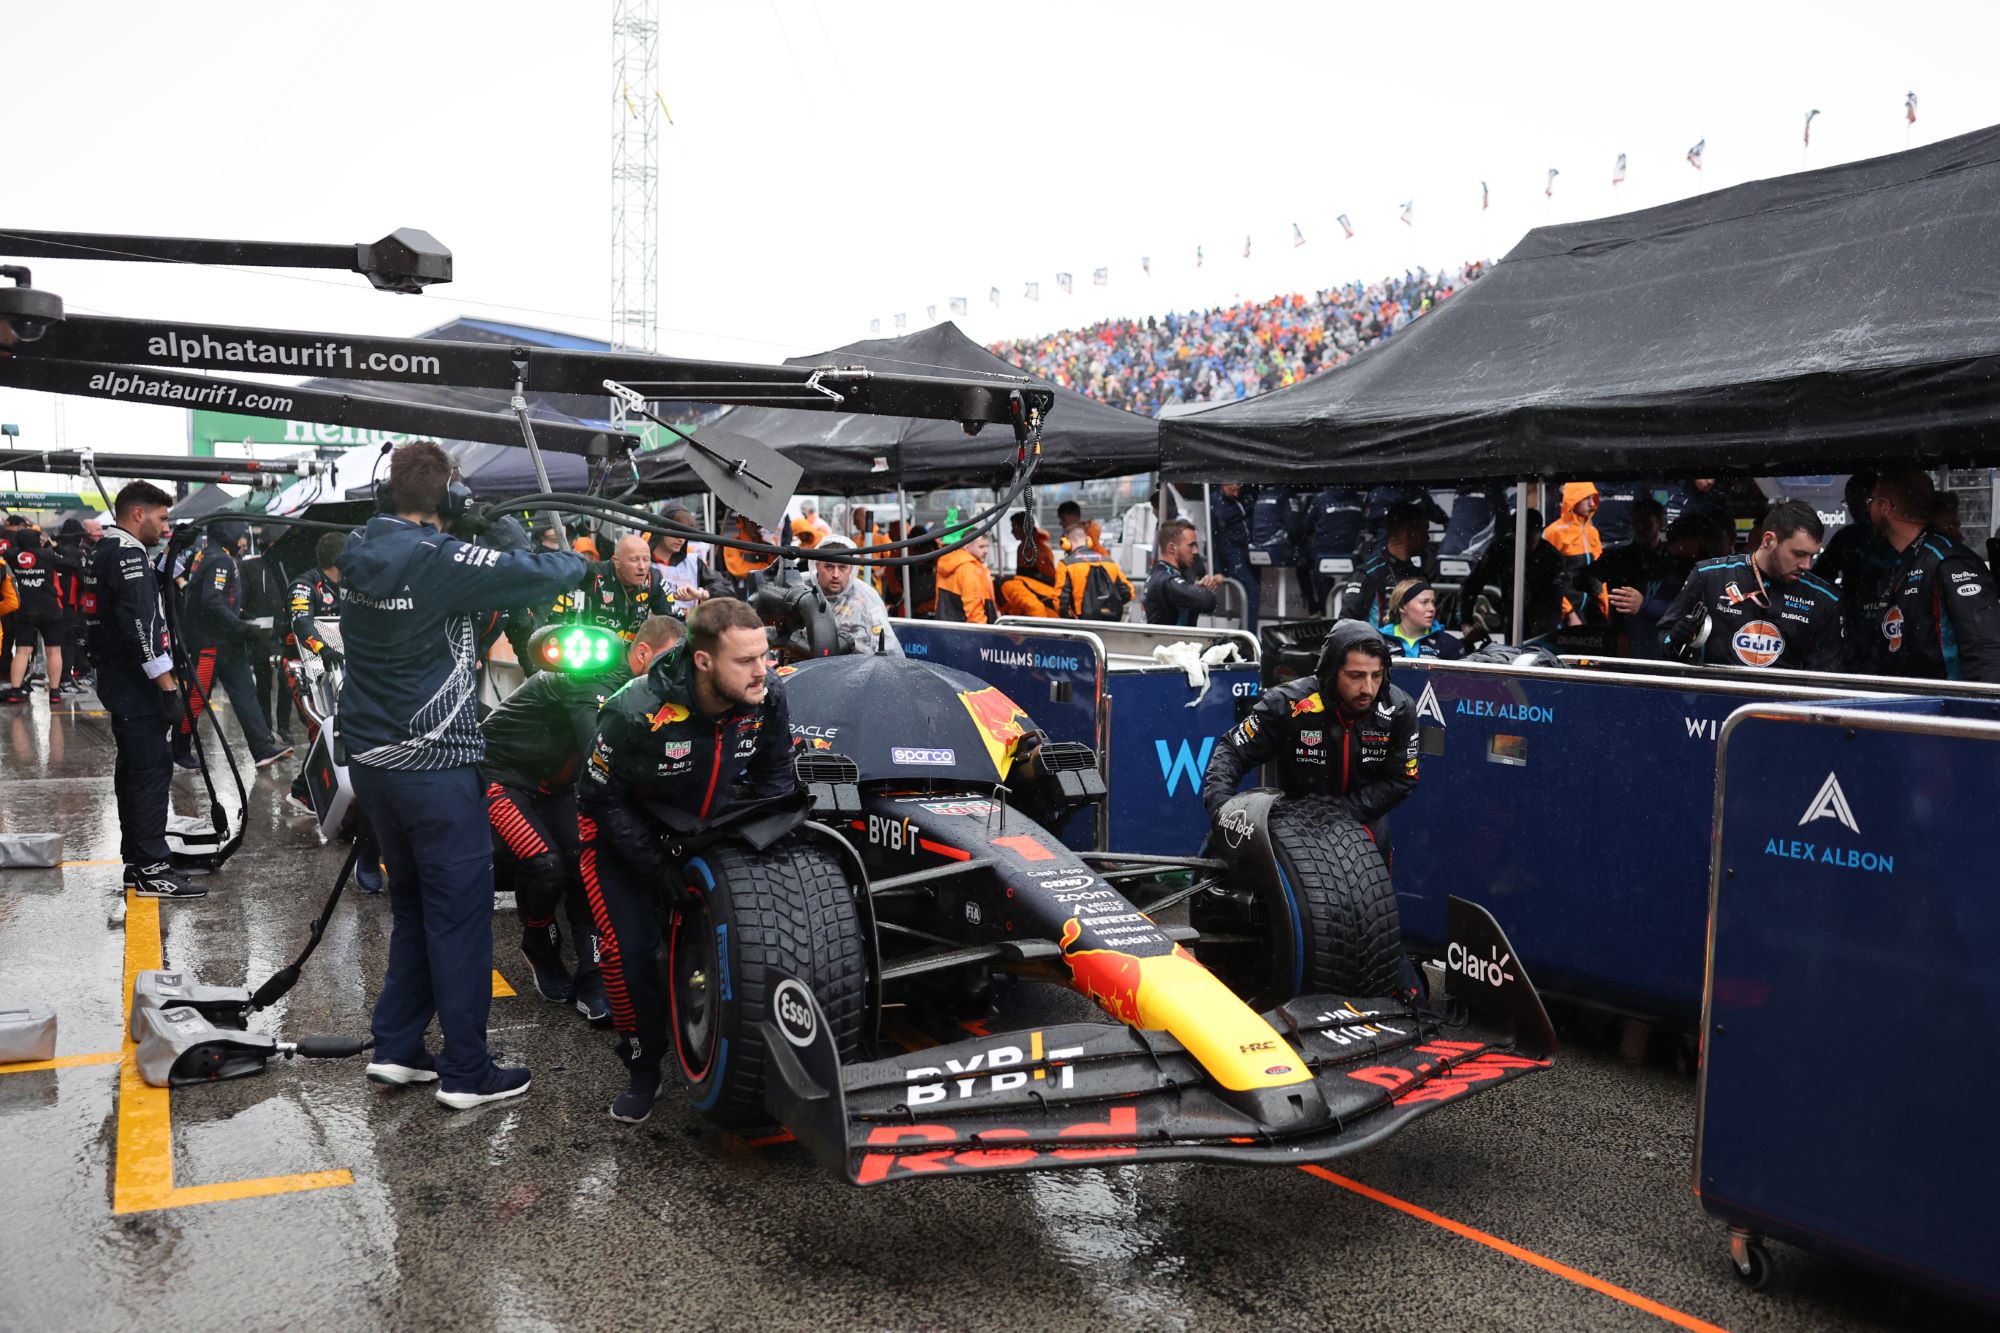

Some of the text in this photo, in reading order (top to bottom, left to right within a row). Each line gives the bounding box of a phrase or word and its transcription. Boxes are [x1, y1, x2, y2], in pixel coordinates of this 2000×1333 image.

[147, 331, 441, 375] alphataurif1.com
[89, 371, 293, 413] alphataurif1.com
[1783, 593, 1815, 606] WILLIAMS
[1785, 600, 1810, 612] RACING
[1716, 602, 1743, 616] Stephens
[905, 644, 928, 656] ALBON
[1736, 634, 1782, 652] Gulf
[980, 647, 1079, 671] WILLIAMS RACING
[1456, 699, 1554, 724] ALEX ALBON
[1685, 717, 1725, 740] WI
[667, 748, 691, 757] HEUER
[894, 749, 953, 764] sparco
[1296, 748, 1319, 756] Mobil
[1296, 757, 1327, 765] ORACLE
[869, 814, 920, 856] BYBIT
[1764, 838, 1894, 874] ALEX ALBON
[1040, 879, 1083, 888] CDW
[1053, 890, 1115, 902] zoom
[1088, 900, 1125, 908] ARCTIC
[1104, 935, 1152, 947] Mobil
[1447, 937, 1508, 987] Claro
[1239, 1041, 1277, 1054] HRC
[905, 1030, 1085, 1107] BYBIT
[857, 1107, 1138, 1186] Red
